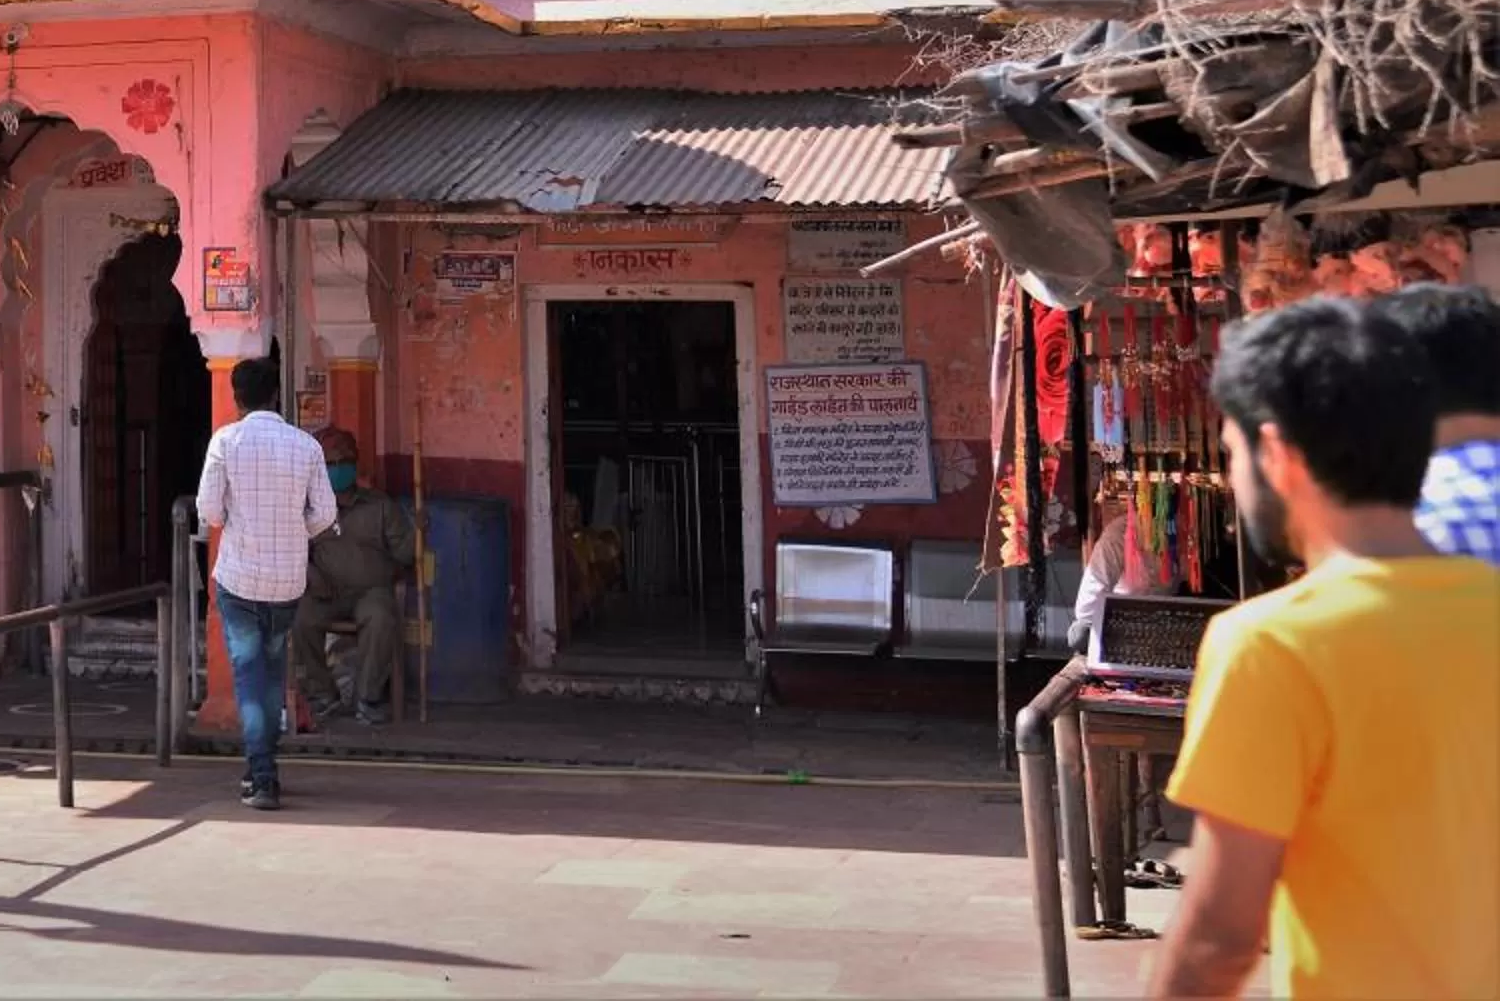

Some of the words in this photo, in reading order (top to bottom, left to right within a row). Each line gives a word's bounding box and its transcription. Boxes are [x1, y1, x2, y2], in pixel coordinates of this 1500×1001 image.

[587, 248, 677, 273] निकास
[770, 373, 832, 390] राजस्थान
[834, 372, 885, 390] सरकार
[886, 367, 912, 387] की
[850, 393, 866, 412] की
